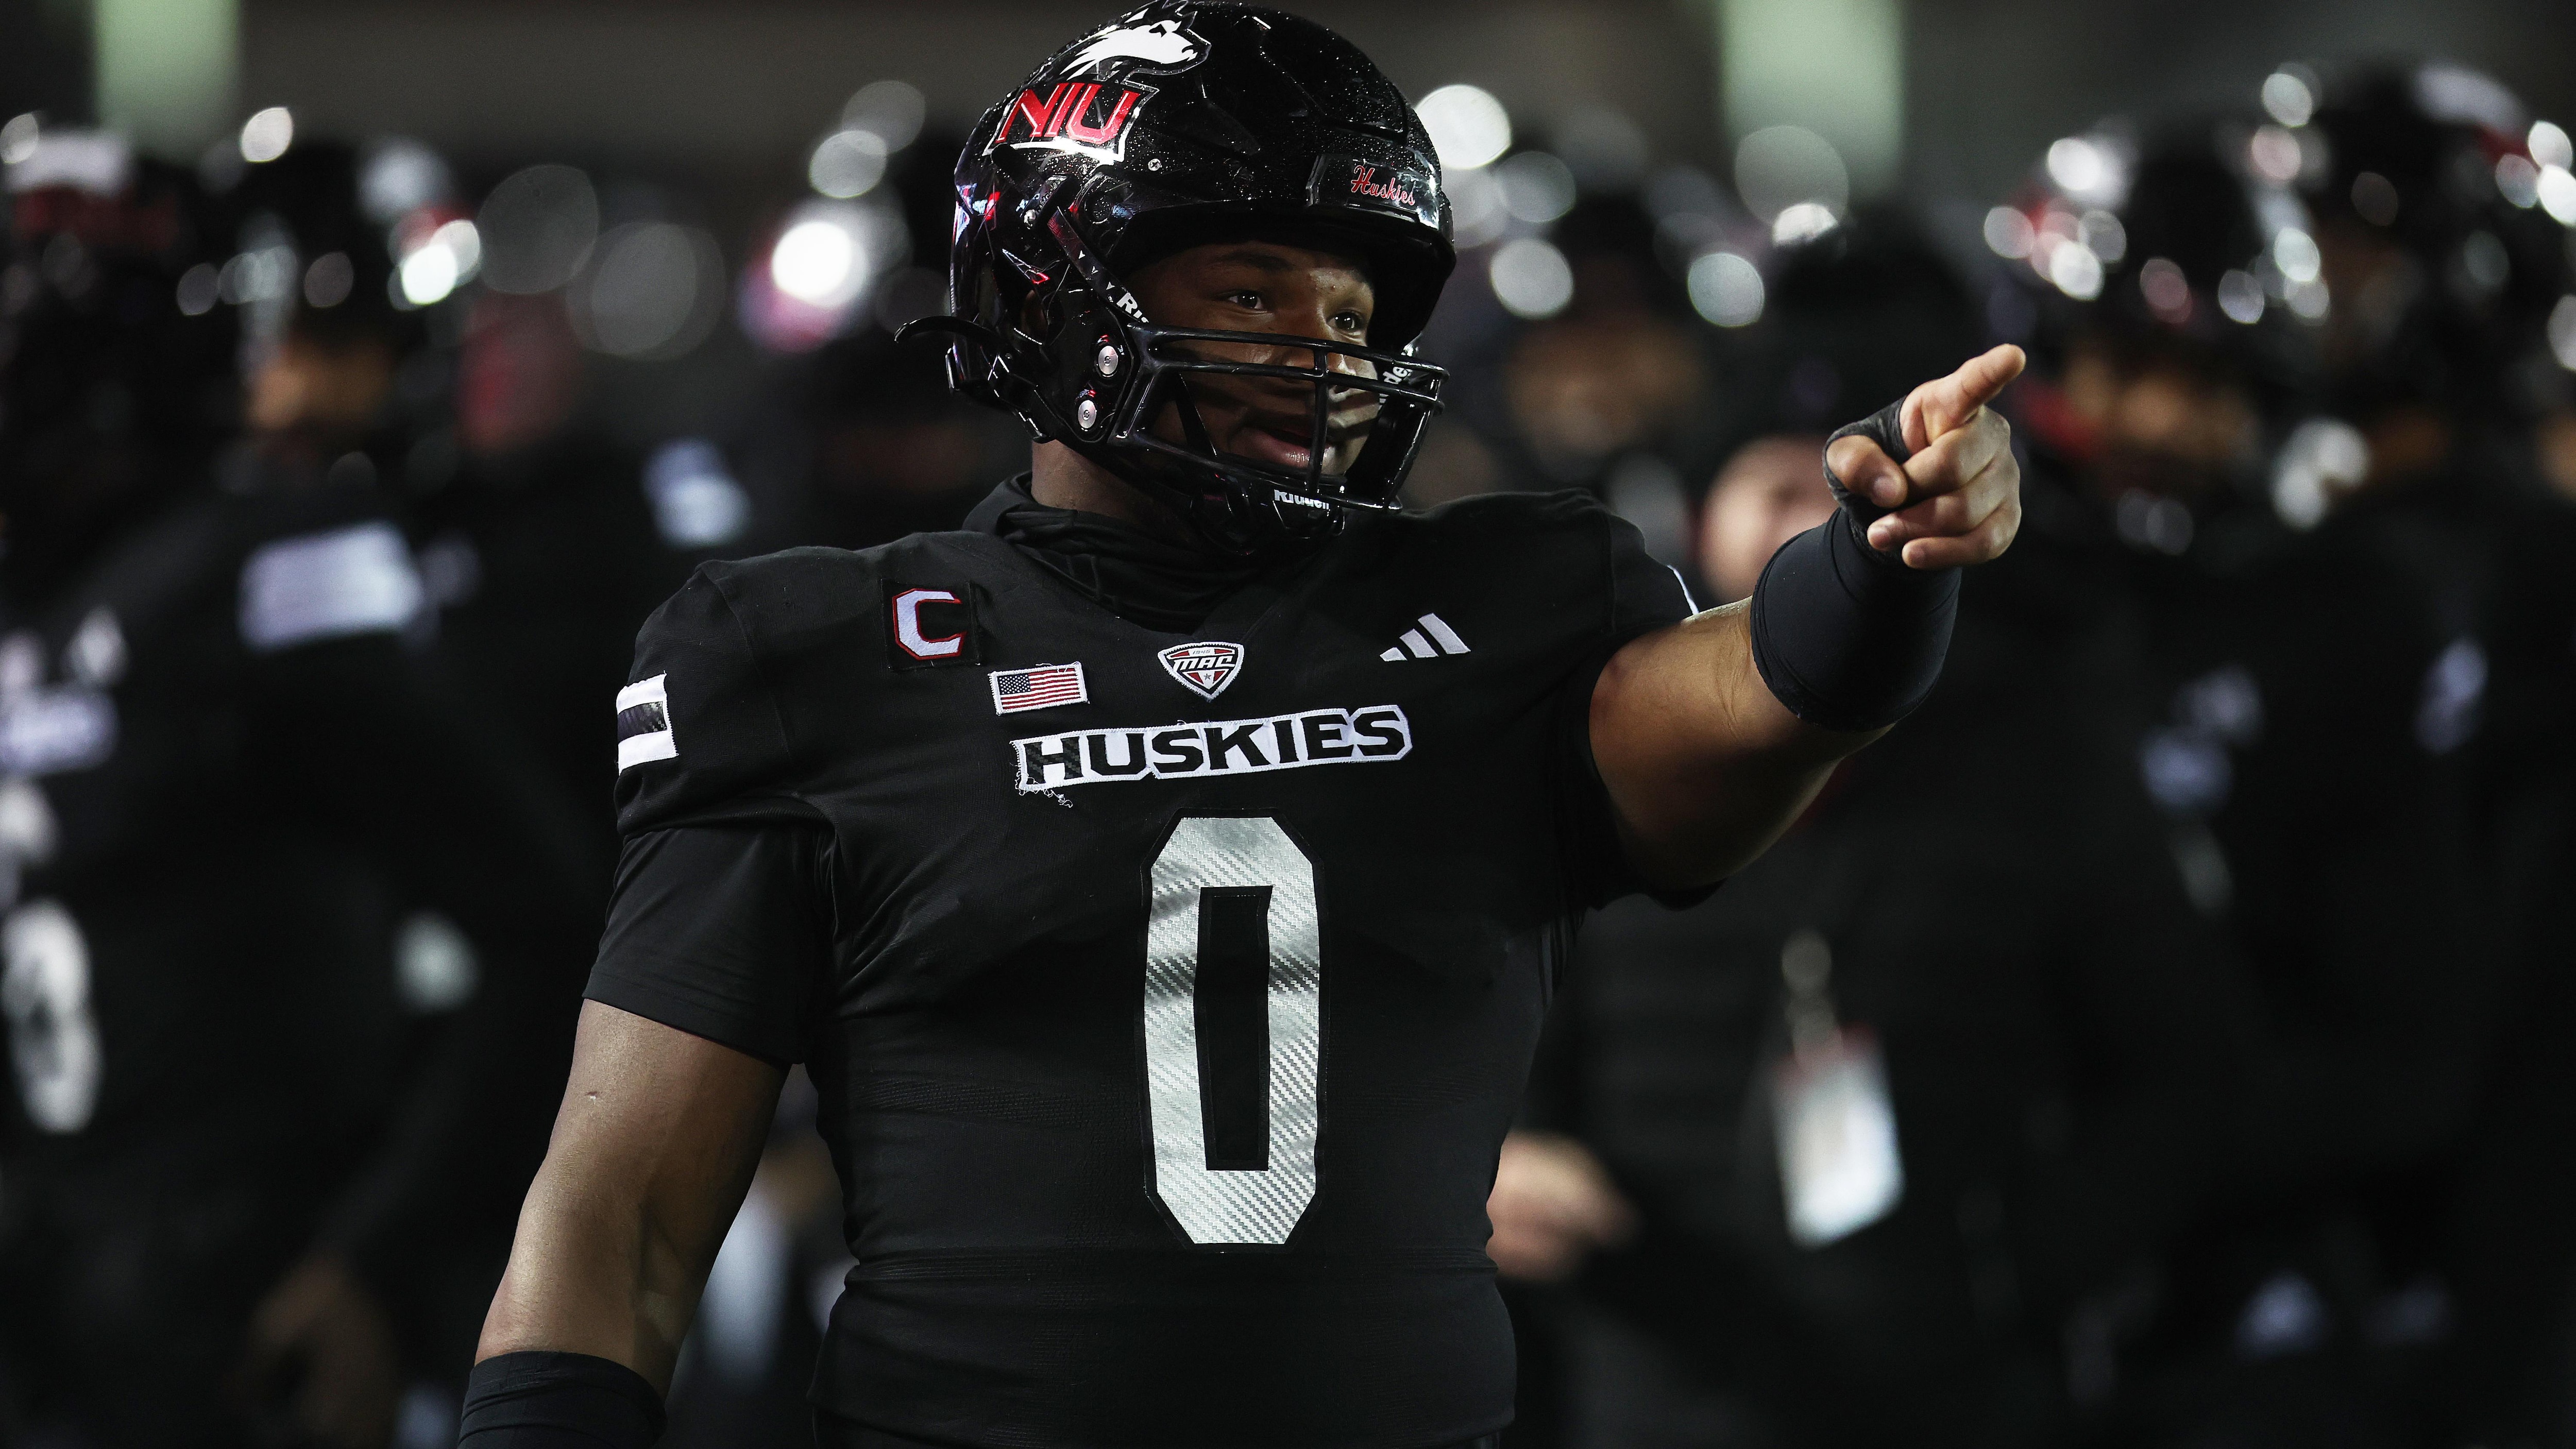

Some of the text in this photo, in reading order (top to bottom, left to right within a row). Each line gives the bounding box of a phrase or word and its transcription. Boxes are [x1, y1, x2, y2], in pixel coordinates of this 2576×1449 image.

[995, 82, 1141, 145] NIU
[1351, 165, 1415, 206] Huskies
[892, 588, 968, 660] C
[1173, 656, 1235, 672] MAC
[1024, 711, 1406, 784] HUSKIES
[1144, 817, 1320, 1244] 0
